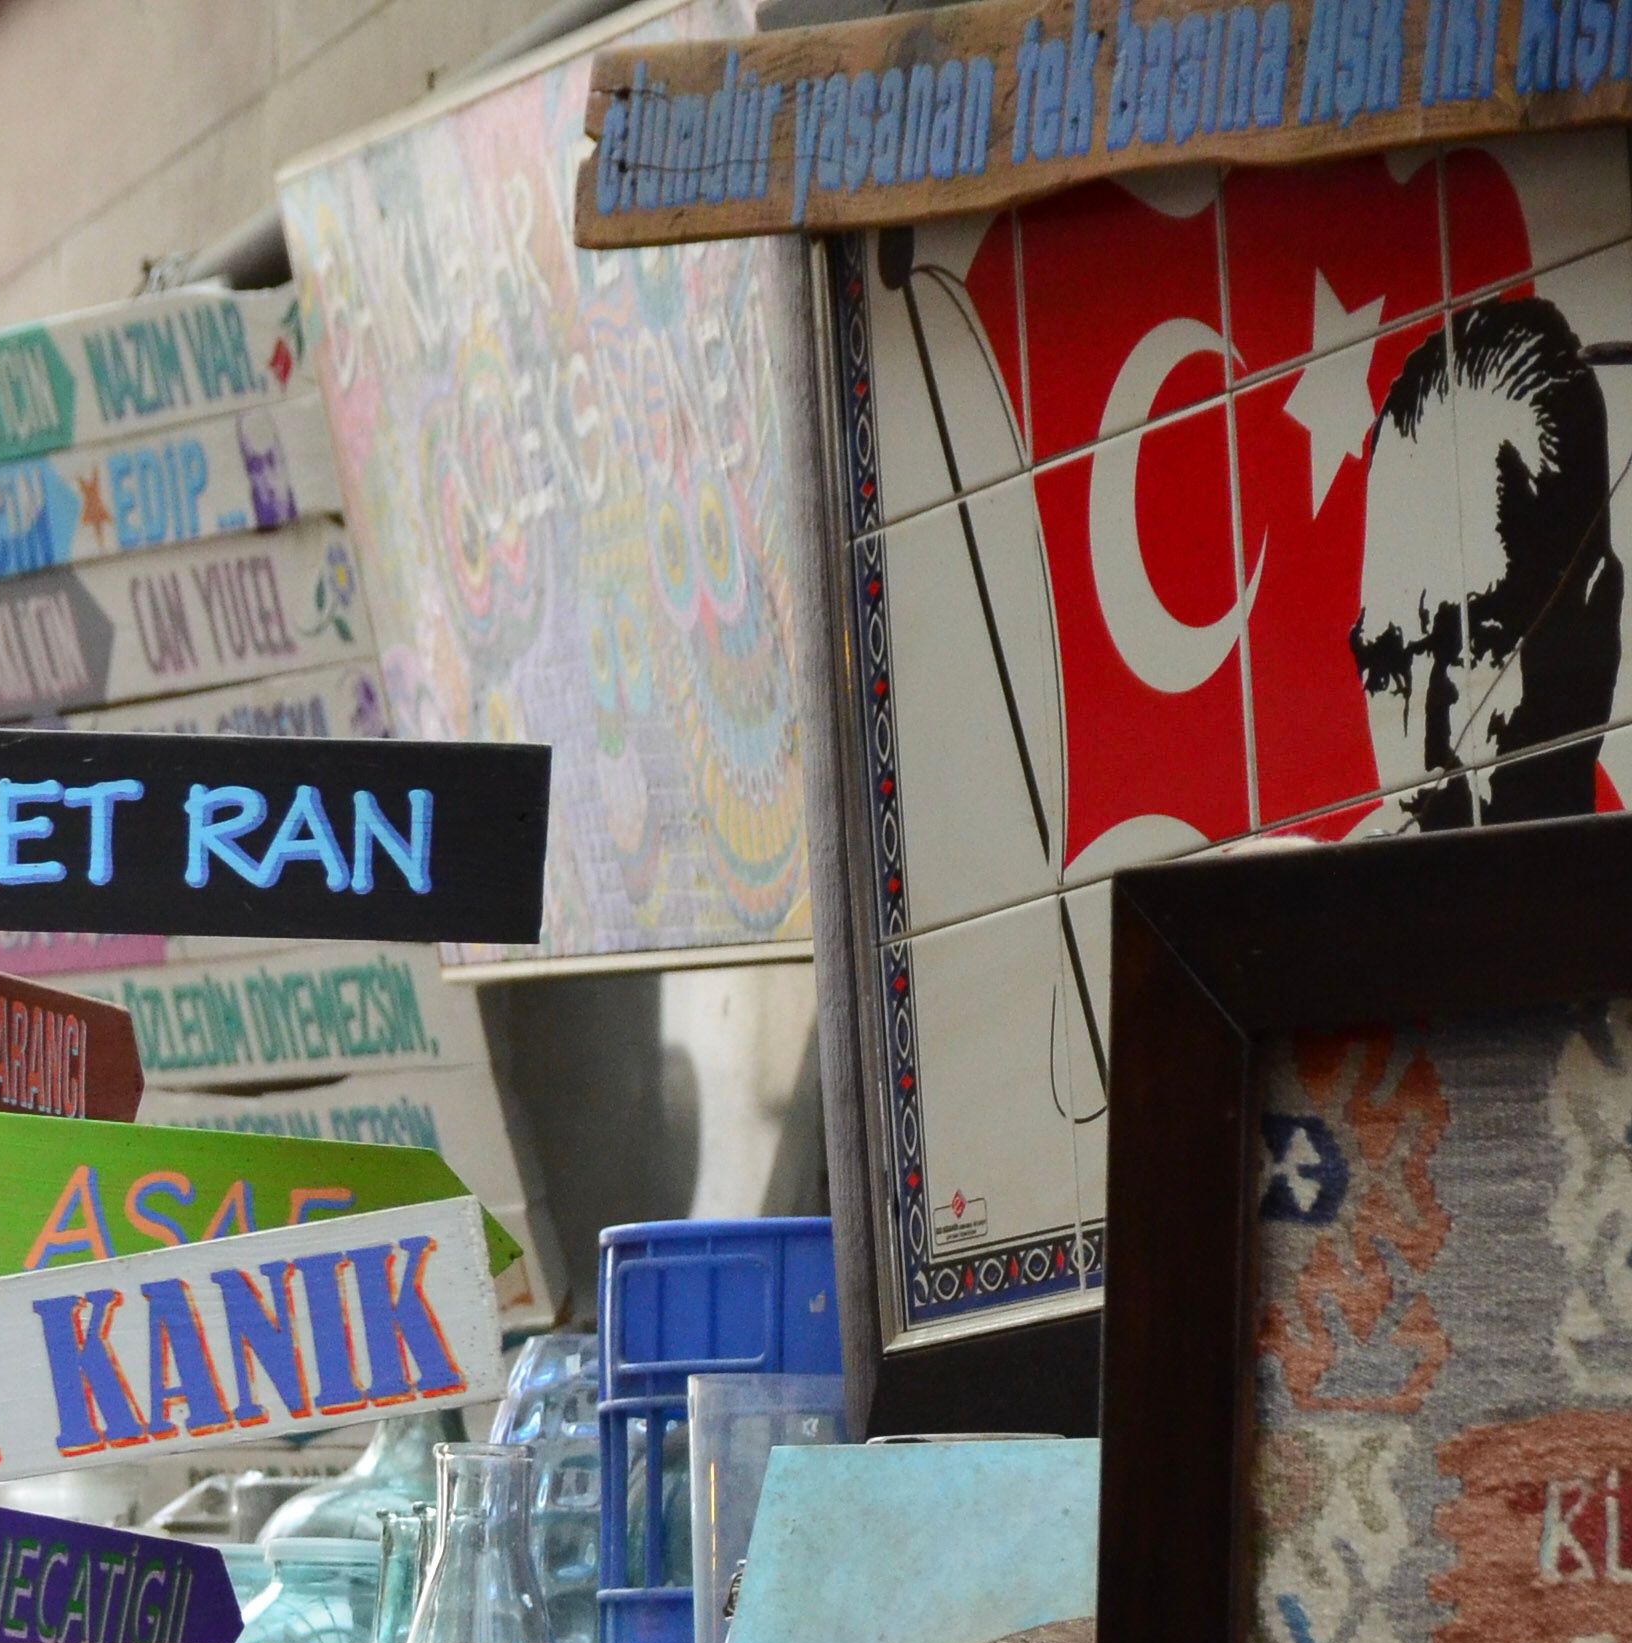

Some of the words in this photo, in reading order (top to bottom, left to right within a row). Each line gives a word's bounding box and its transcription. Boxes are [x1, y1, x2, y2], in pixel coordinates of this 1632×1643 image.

[1010, 0, 1105, 164] tek
[185, 782, 435, 896] RAN
[33, 1235, 467, 1457] KANIK
